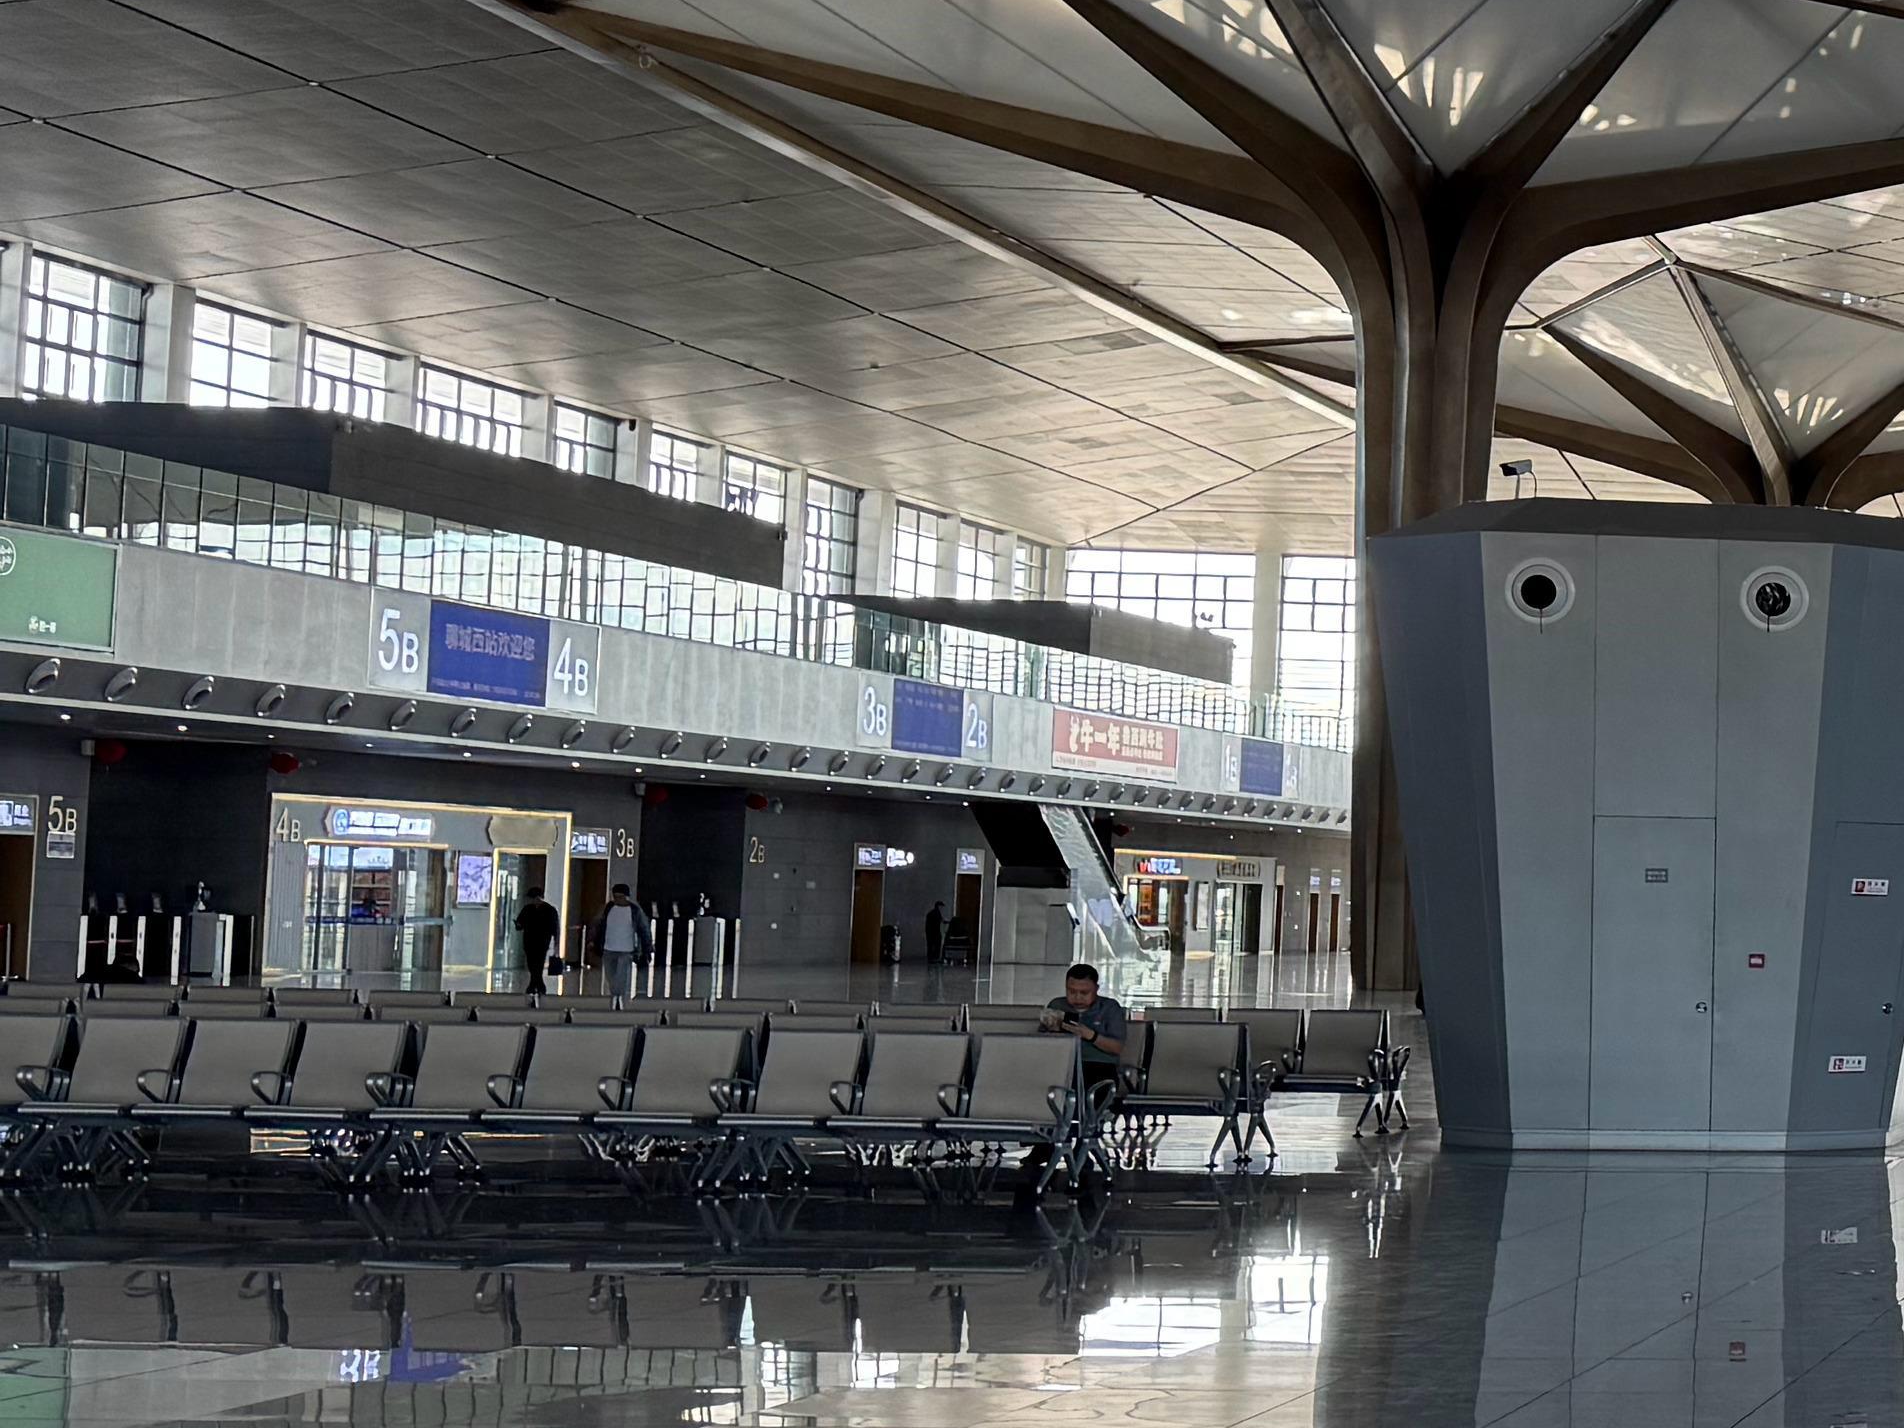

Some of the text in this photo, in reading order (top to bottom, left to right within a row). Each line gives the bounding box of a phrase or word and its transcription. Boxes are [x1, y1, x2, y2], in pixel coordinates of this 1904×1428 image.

[378, 608, 419, 673] 5B
[444, 622, 535, 661] 聊城西站欢迎您
[553, 637, 589, 696] 4B
[863, 686, 887, 736] 3B
[966, 702, 988, 749] 2B
[47, 795, 77, 833] 5B
[275, 807, 300, 842] 4B
[616, 828, 635, 858] 3B
[749, 837, 765, 863] 2B
